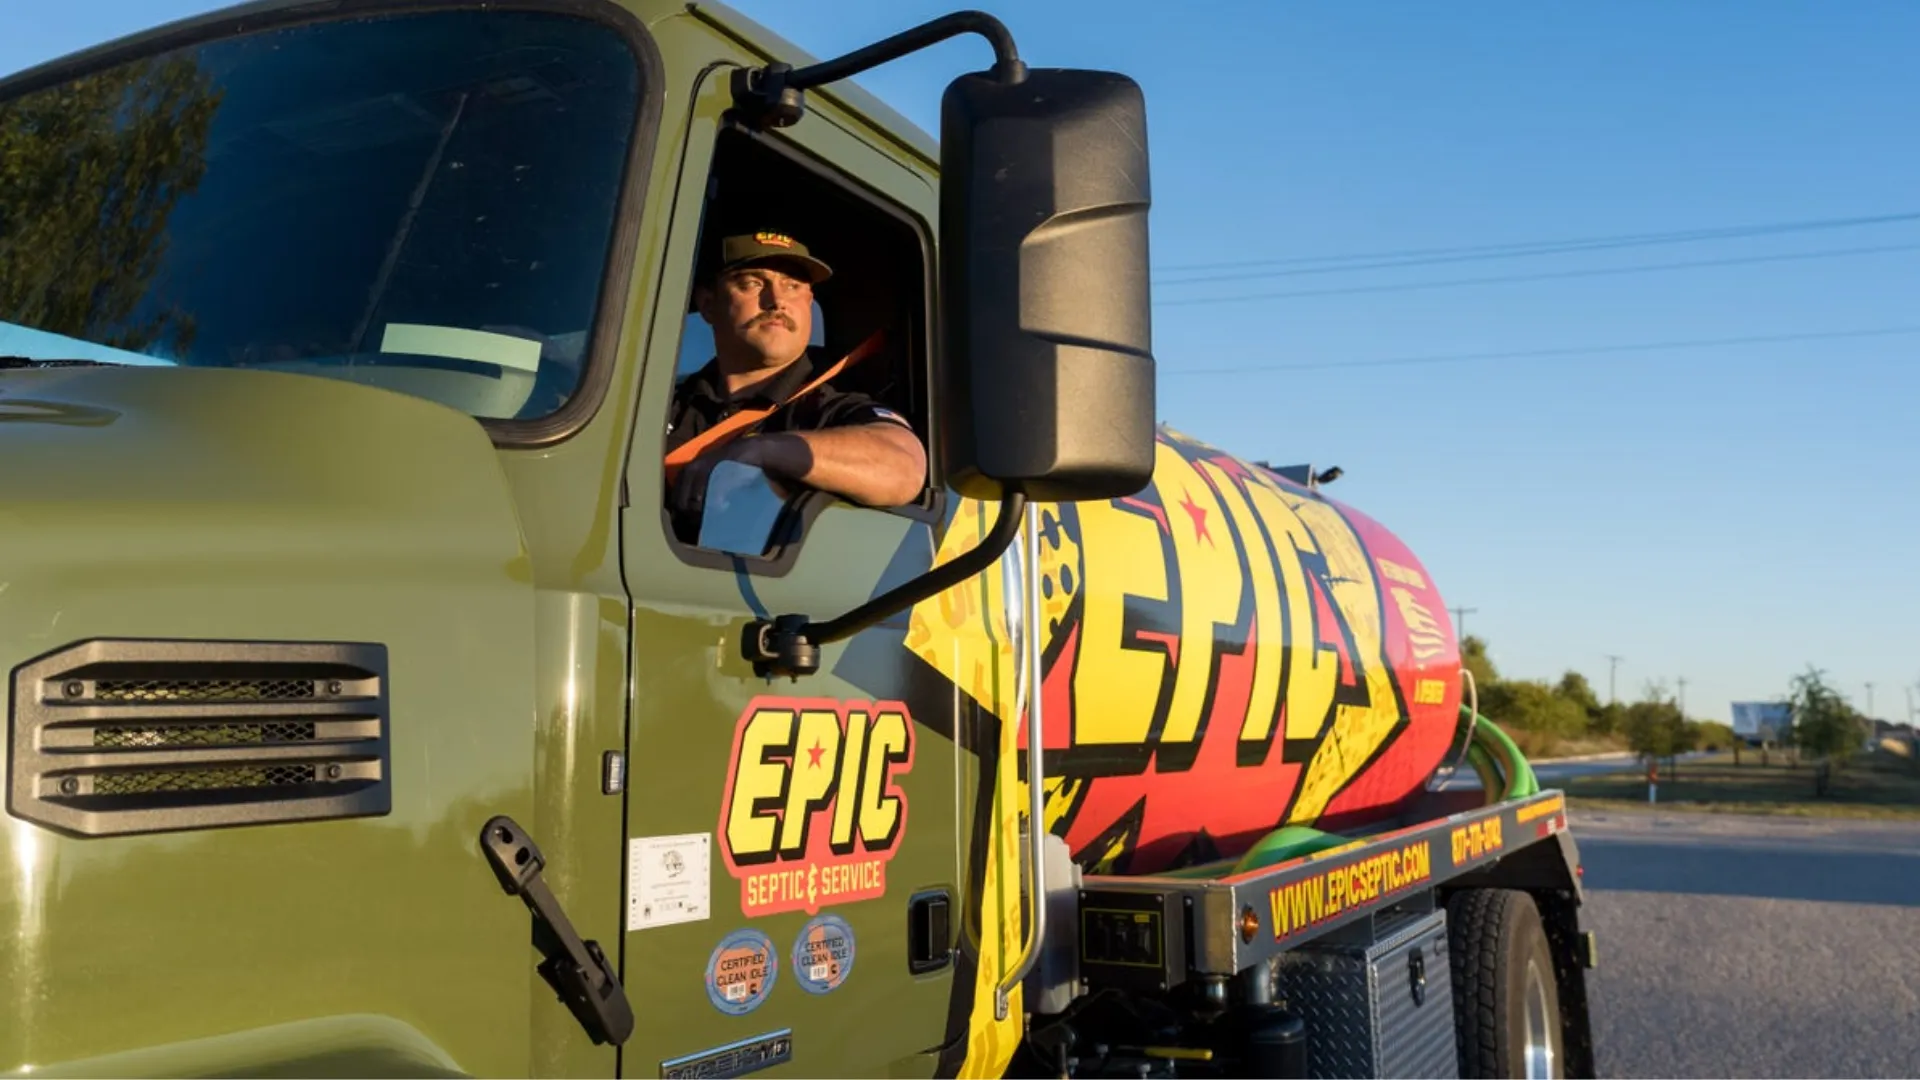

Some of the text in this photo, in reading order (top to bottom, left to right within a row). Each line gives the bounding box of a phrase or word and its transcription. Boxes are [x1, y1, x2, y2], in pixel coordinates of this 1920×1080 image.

[1073, 440, 1339, 746] EPIC
[727, 709, 909, 861] EPIC
[747, 861, 881, 906] SEPTIC & SERVICE
[1270, 840, 1431, 939] WWW.EPICSEPTIC.COM
[802, 948, 847, 966] CLEAN IDLE
[805, 936, 844, 953] CERTIFIED
[717, 966, 768, 987] CLEAN IDLE
[721, 954, 766, 971] CERTIFIED
